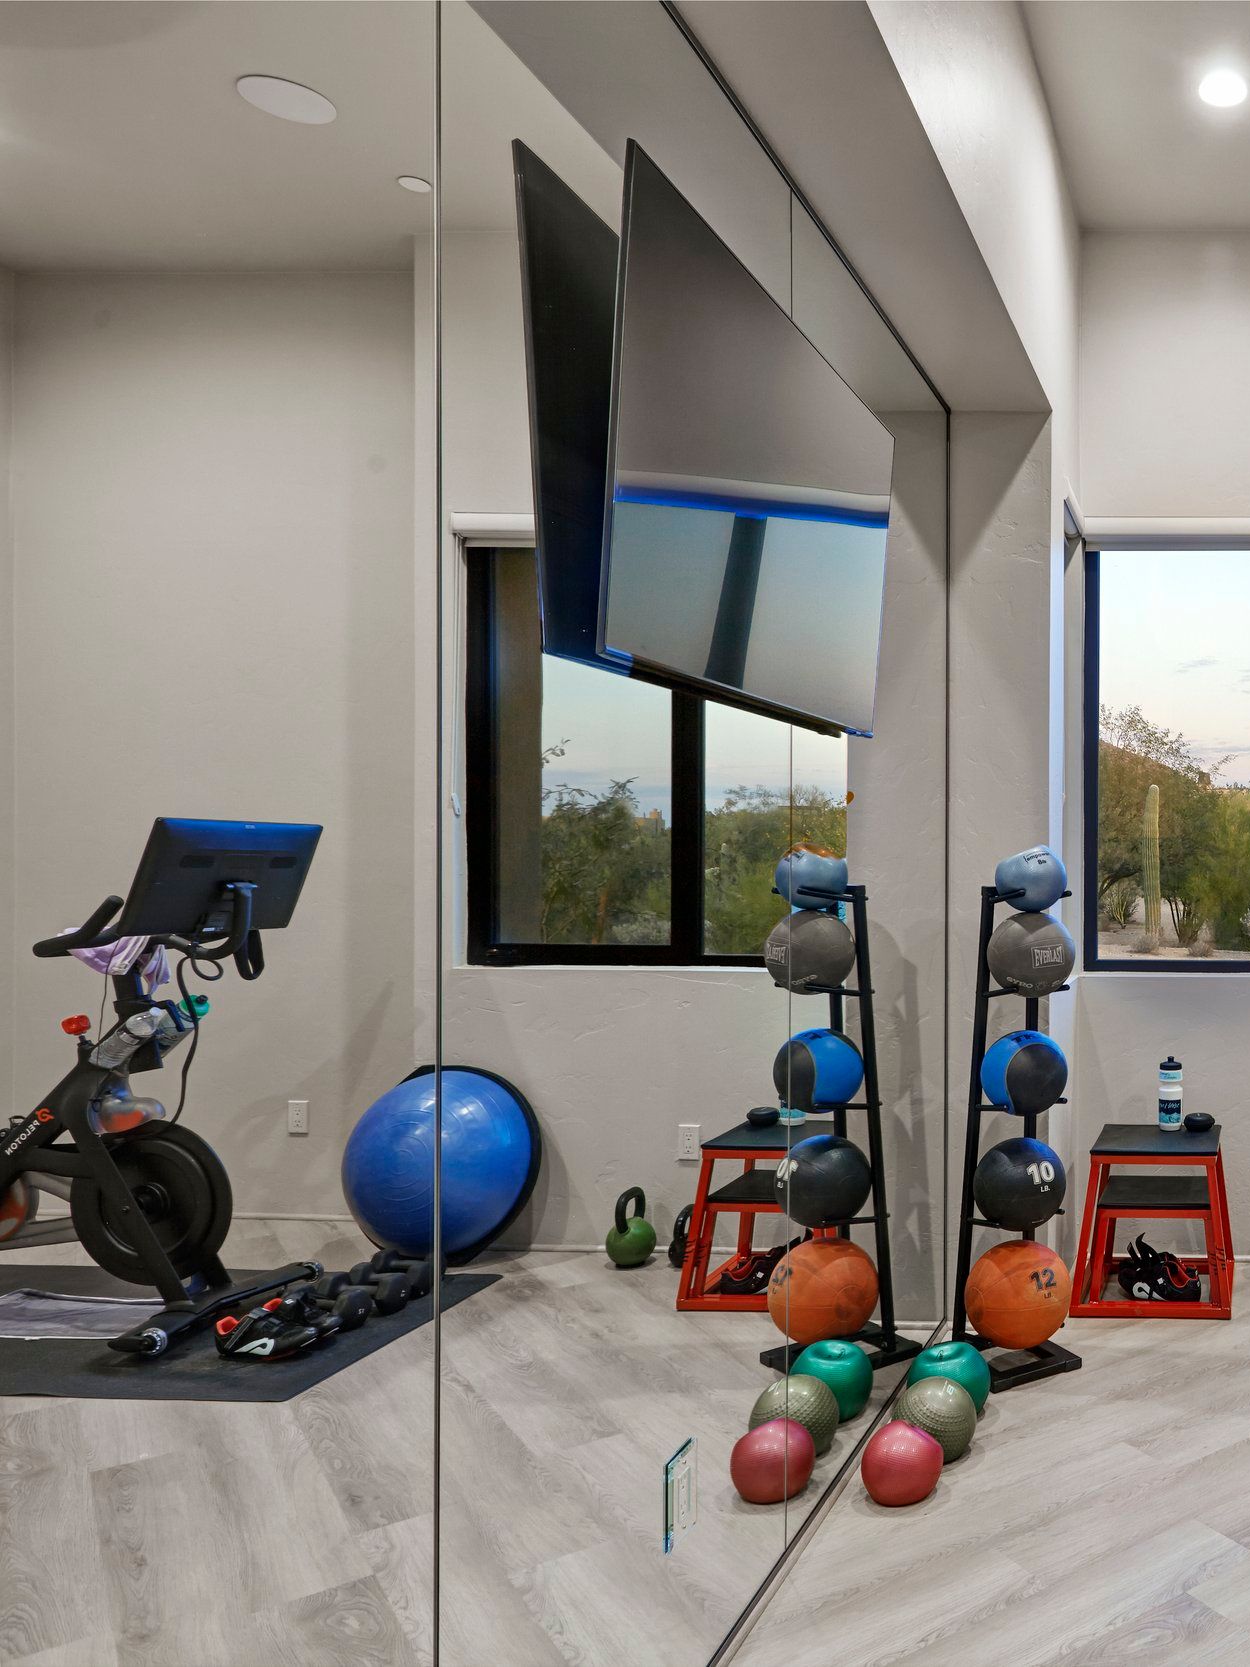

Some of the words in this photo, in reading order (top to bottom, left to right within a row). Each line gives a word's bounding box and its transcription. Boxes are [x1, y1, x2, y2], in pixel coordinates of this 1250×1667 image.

[1034, 946, 1063, 967] EVERLAST
[1026, 1160, 1055, 1185] 10
[1030, 1267, 1057, 1290] 12
